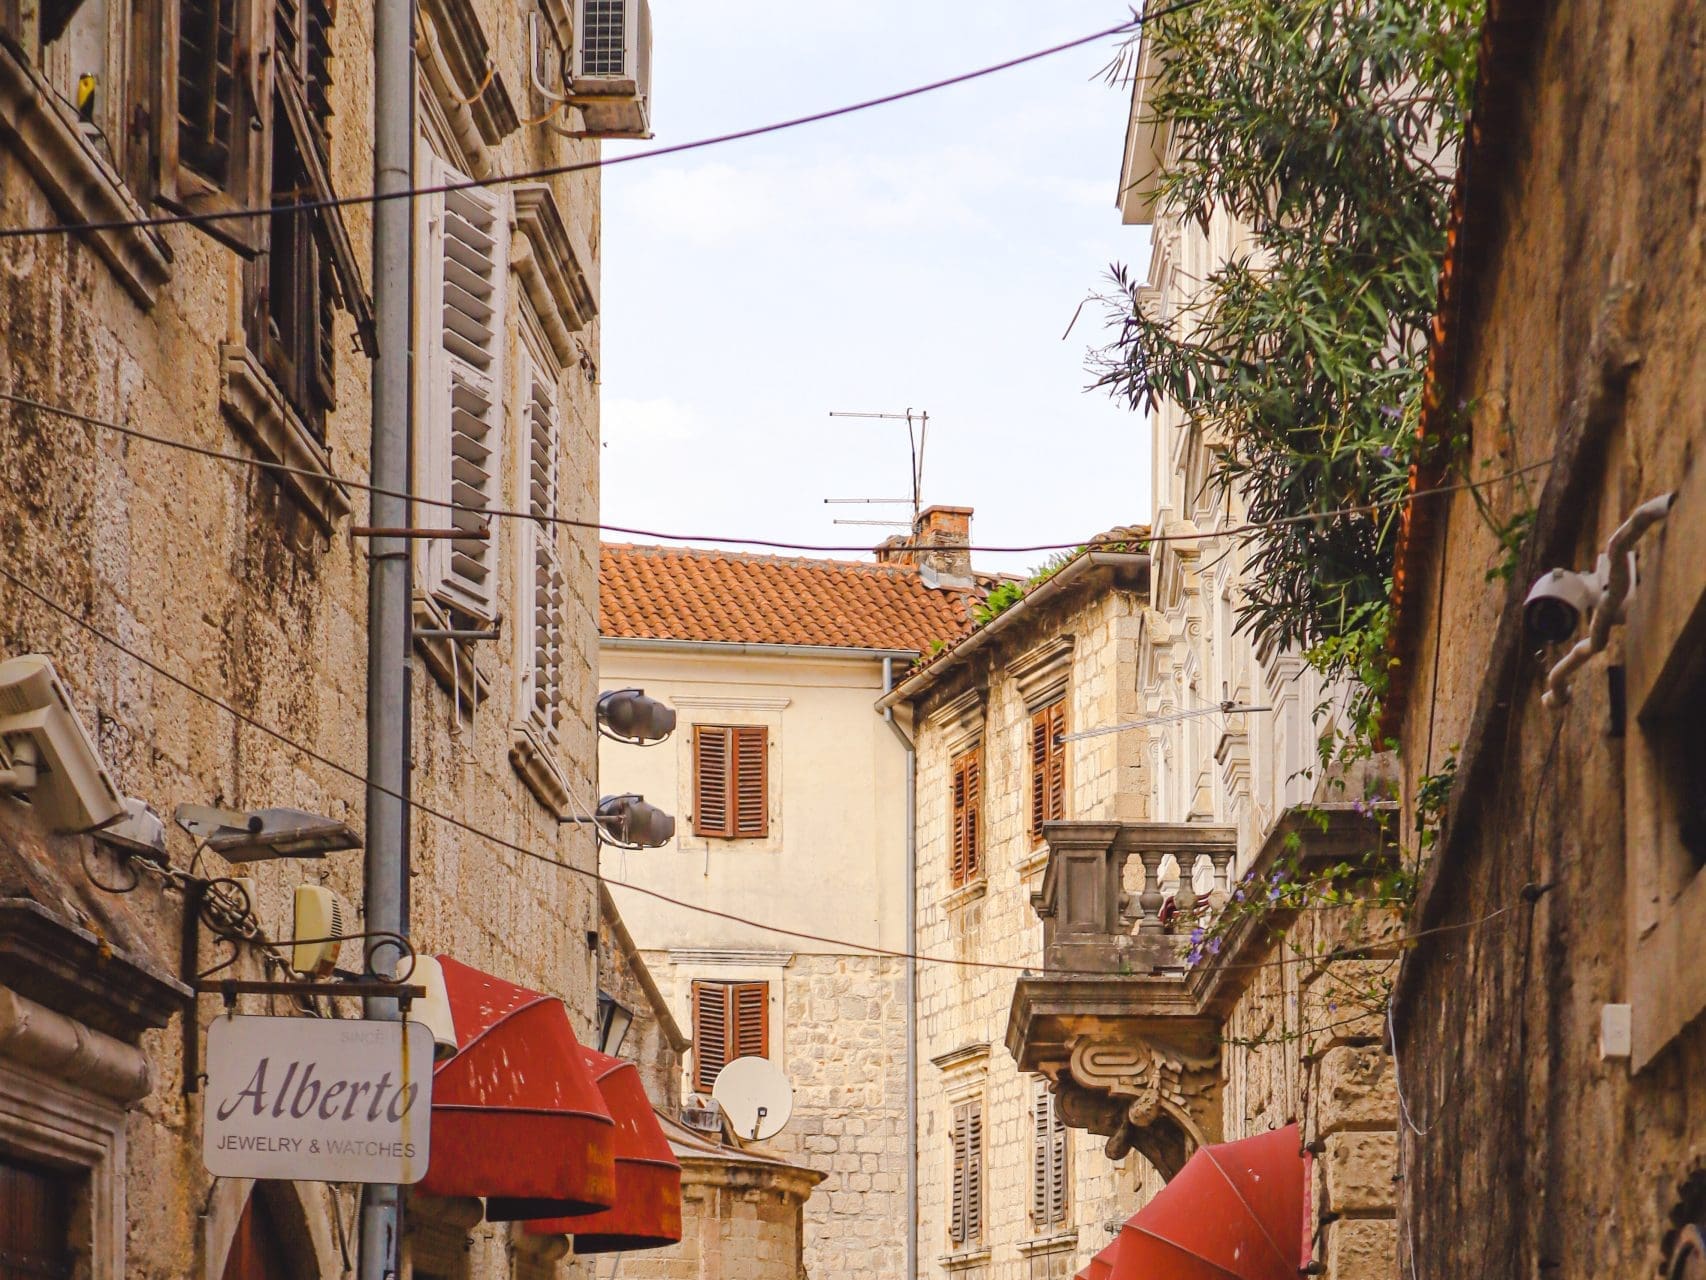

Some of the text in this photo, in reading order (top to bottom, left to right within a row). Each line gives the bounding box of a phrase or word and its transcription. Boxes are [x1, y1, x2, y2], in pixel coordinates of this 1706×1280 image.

[216, 1057, 418, 1123] Alberto
[217, 1135, 416, 1158] JEWELRY & WATCHES
